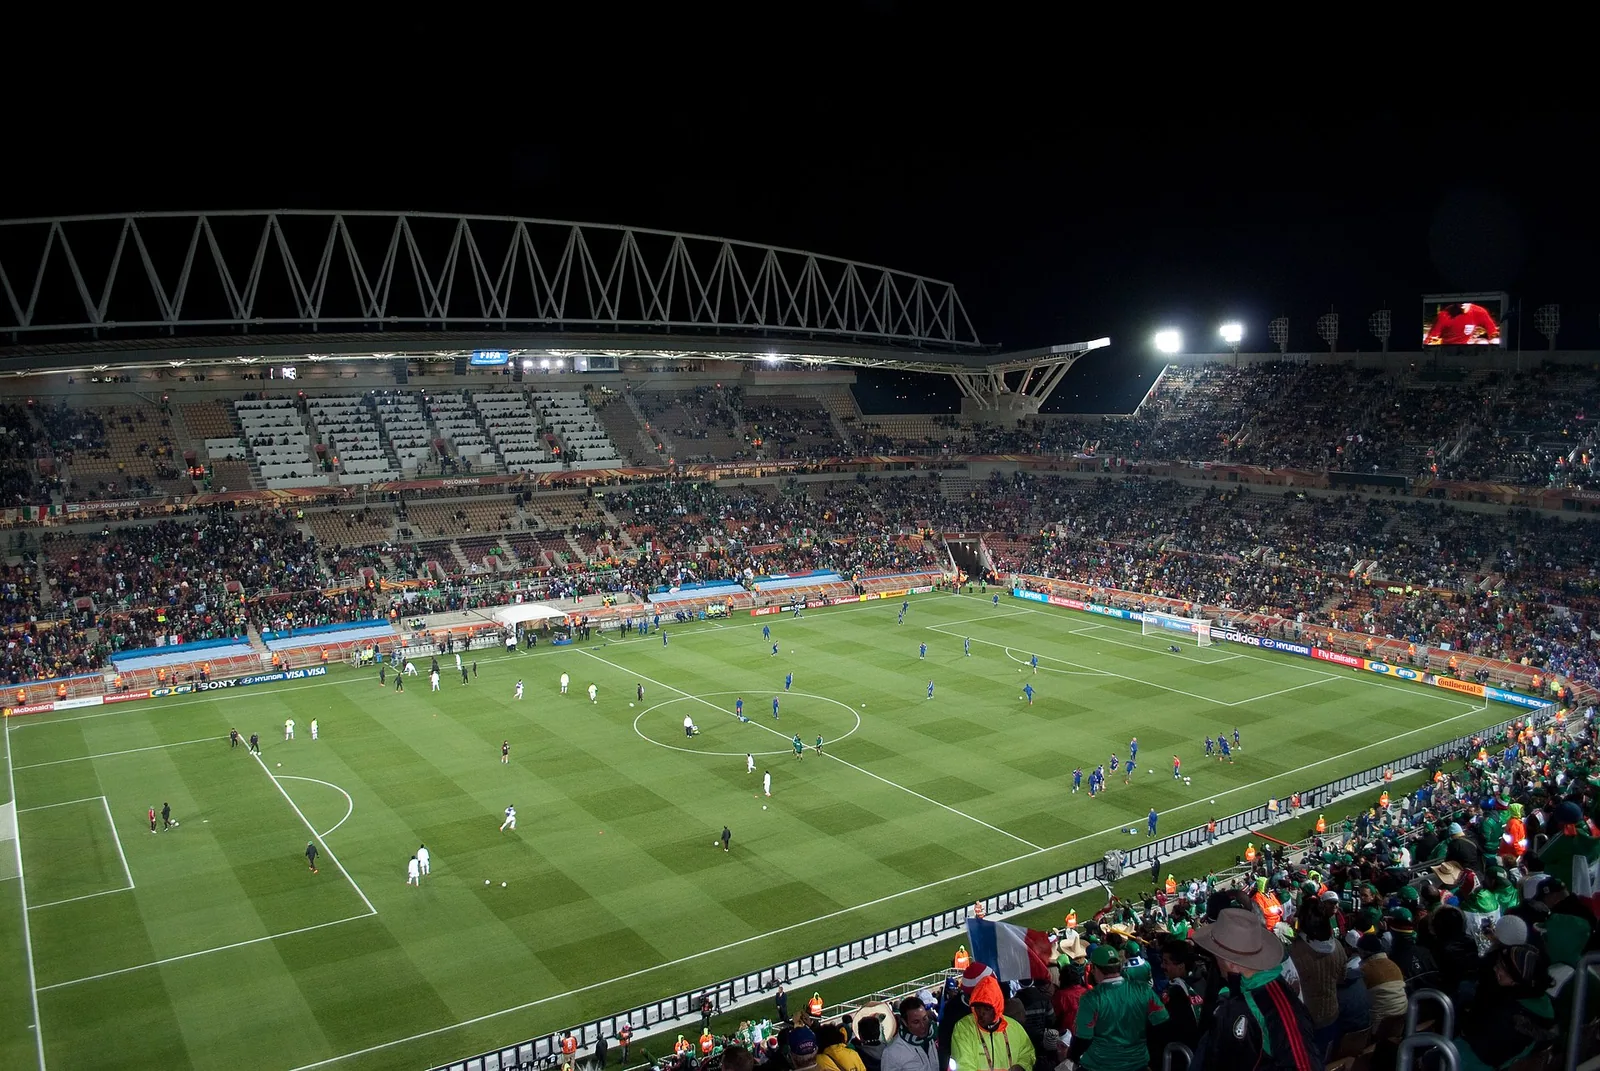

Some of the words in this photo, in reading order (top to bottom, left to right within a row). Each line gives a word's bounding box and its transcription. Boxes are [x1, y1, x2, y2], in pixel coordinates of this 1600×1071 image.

[480, 351, 501, 360] FIFA
[1226, 630, 1260, 646] adidas
[1276, 641, 1309, 655] HYUNDAI
[1318, 649, 1329, 660] Fly
[1329, 651, 1358, 665] Emirates
[285, 669, 305, 679] VISA
[306, 667, 326, 676] VISA
[254, 674, 284, 683] HYUNDAI
[201, 679, 237, 690] SONY
[1438, 677, 1476, 693] Continental
[13, 704, 54, 714] McDonald's
